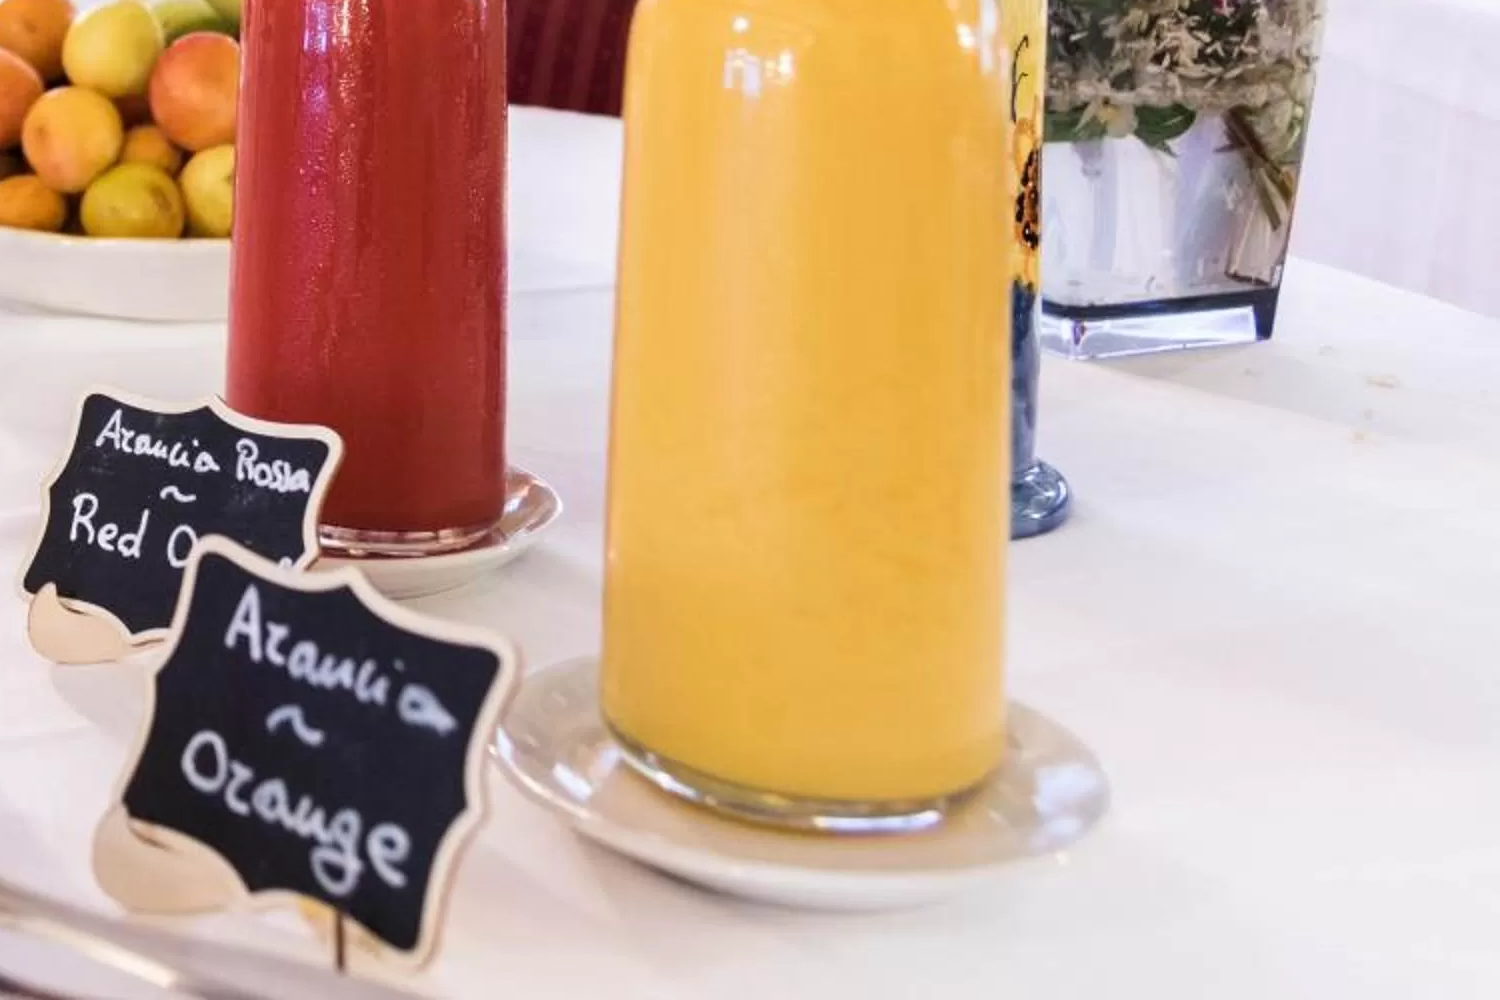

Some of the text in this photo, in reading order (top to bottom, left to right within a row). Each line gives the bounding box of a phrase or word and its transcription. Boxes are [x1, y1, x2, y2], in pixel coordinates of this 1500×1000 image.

[95, 409, 311, 493] Arancia Rossa
[69, 493, 149, 558] Red
[223, 584, 458, 738] Arancia
[180, 730, 411, 896] Orange
